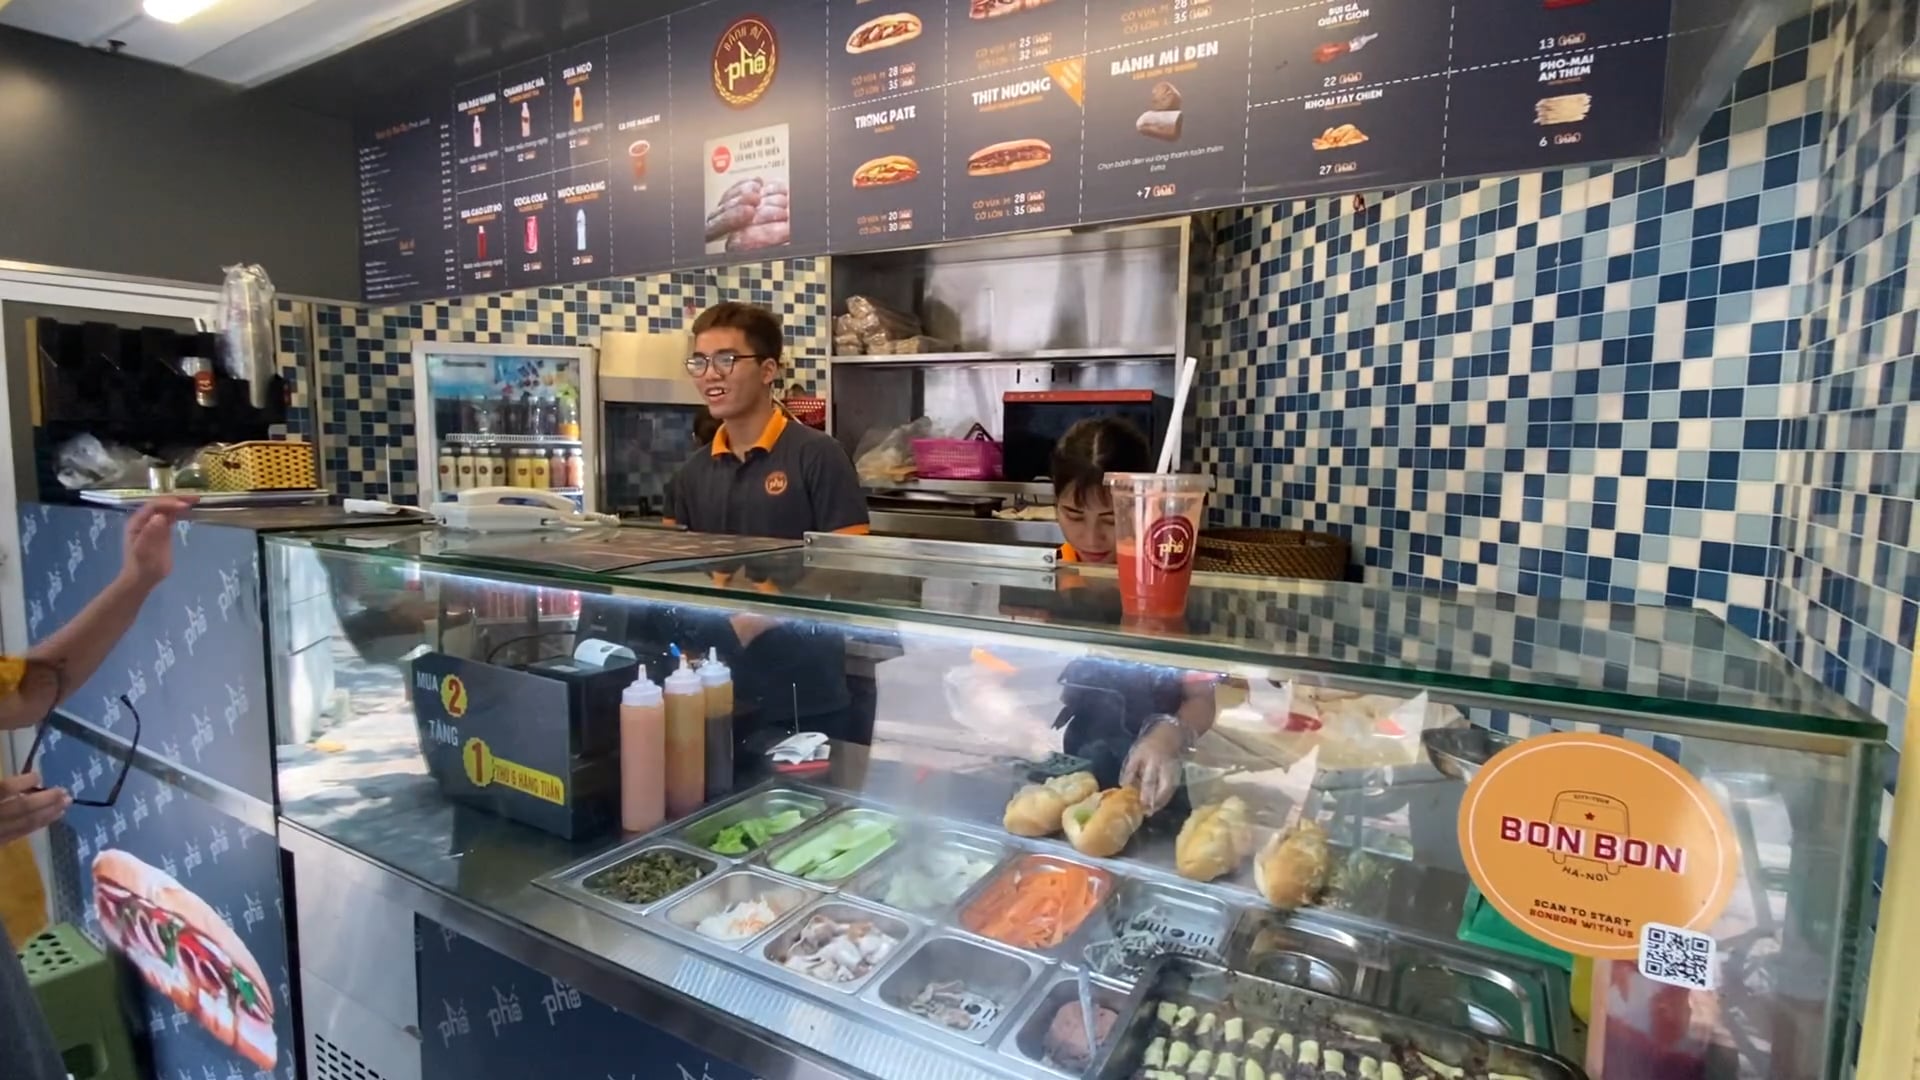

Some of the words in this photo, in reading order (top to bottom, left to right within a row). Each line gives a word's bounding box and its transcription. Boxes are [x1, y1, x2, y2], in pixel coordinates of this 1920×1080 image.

[1174, 10, 1188, 24] 35
[1019, 36, 1031, 48] 25
[1538, 38, 1554, 50] 13
[1019, 49, 1030, 61] 32
[888, 66, 898, 78] 28
[888, 78, 898, 90] 35
[1323, 76, 1337, 88] 22
[889, 105, 916, 123] PATE
[1538, 136, 1548, 147] 6
[1319, 165, 1332, 176] 27
[514, 196, 531, 207] COCA
[532, 192, 548, 203] COLA
[1014, 192, 1026, 204] 28
[888, 211, 898, 221] 20
[1014, 205, 1025, 216] 35
[888, 222, 898, 232] 30
[416, 670, 439, 692] MUA
[448, 678, 462, 714] 2
[472, 743, 483, 783] 1
[1500, 815, 1585, 856] BON
[1594, 832, 1687, 874] BON
[1534, 898, 1567, 914] SCAN
[1570, 906, 1587, 917] TO
[1590, 911, 1632, 927] START
[1529, 908, 1578, 926] BONBON
[1581, 920, 1613, 936] WITH
[1618, 928, 1634, 940] US
